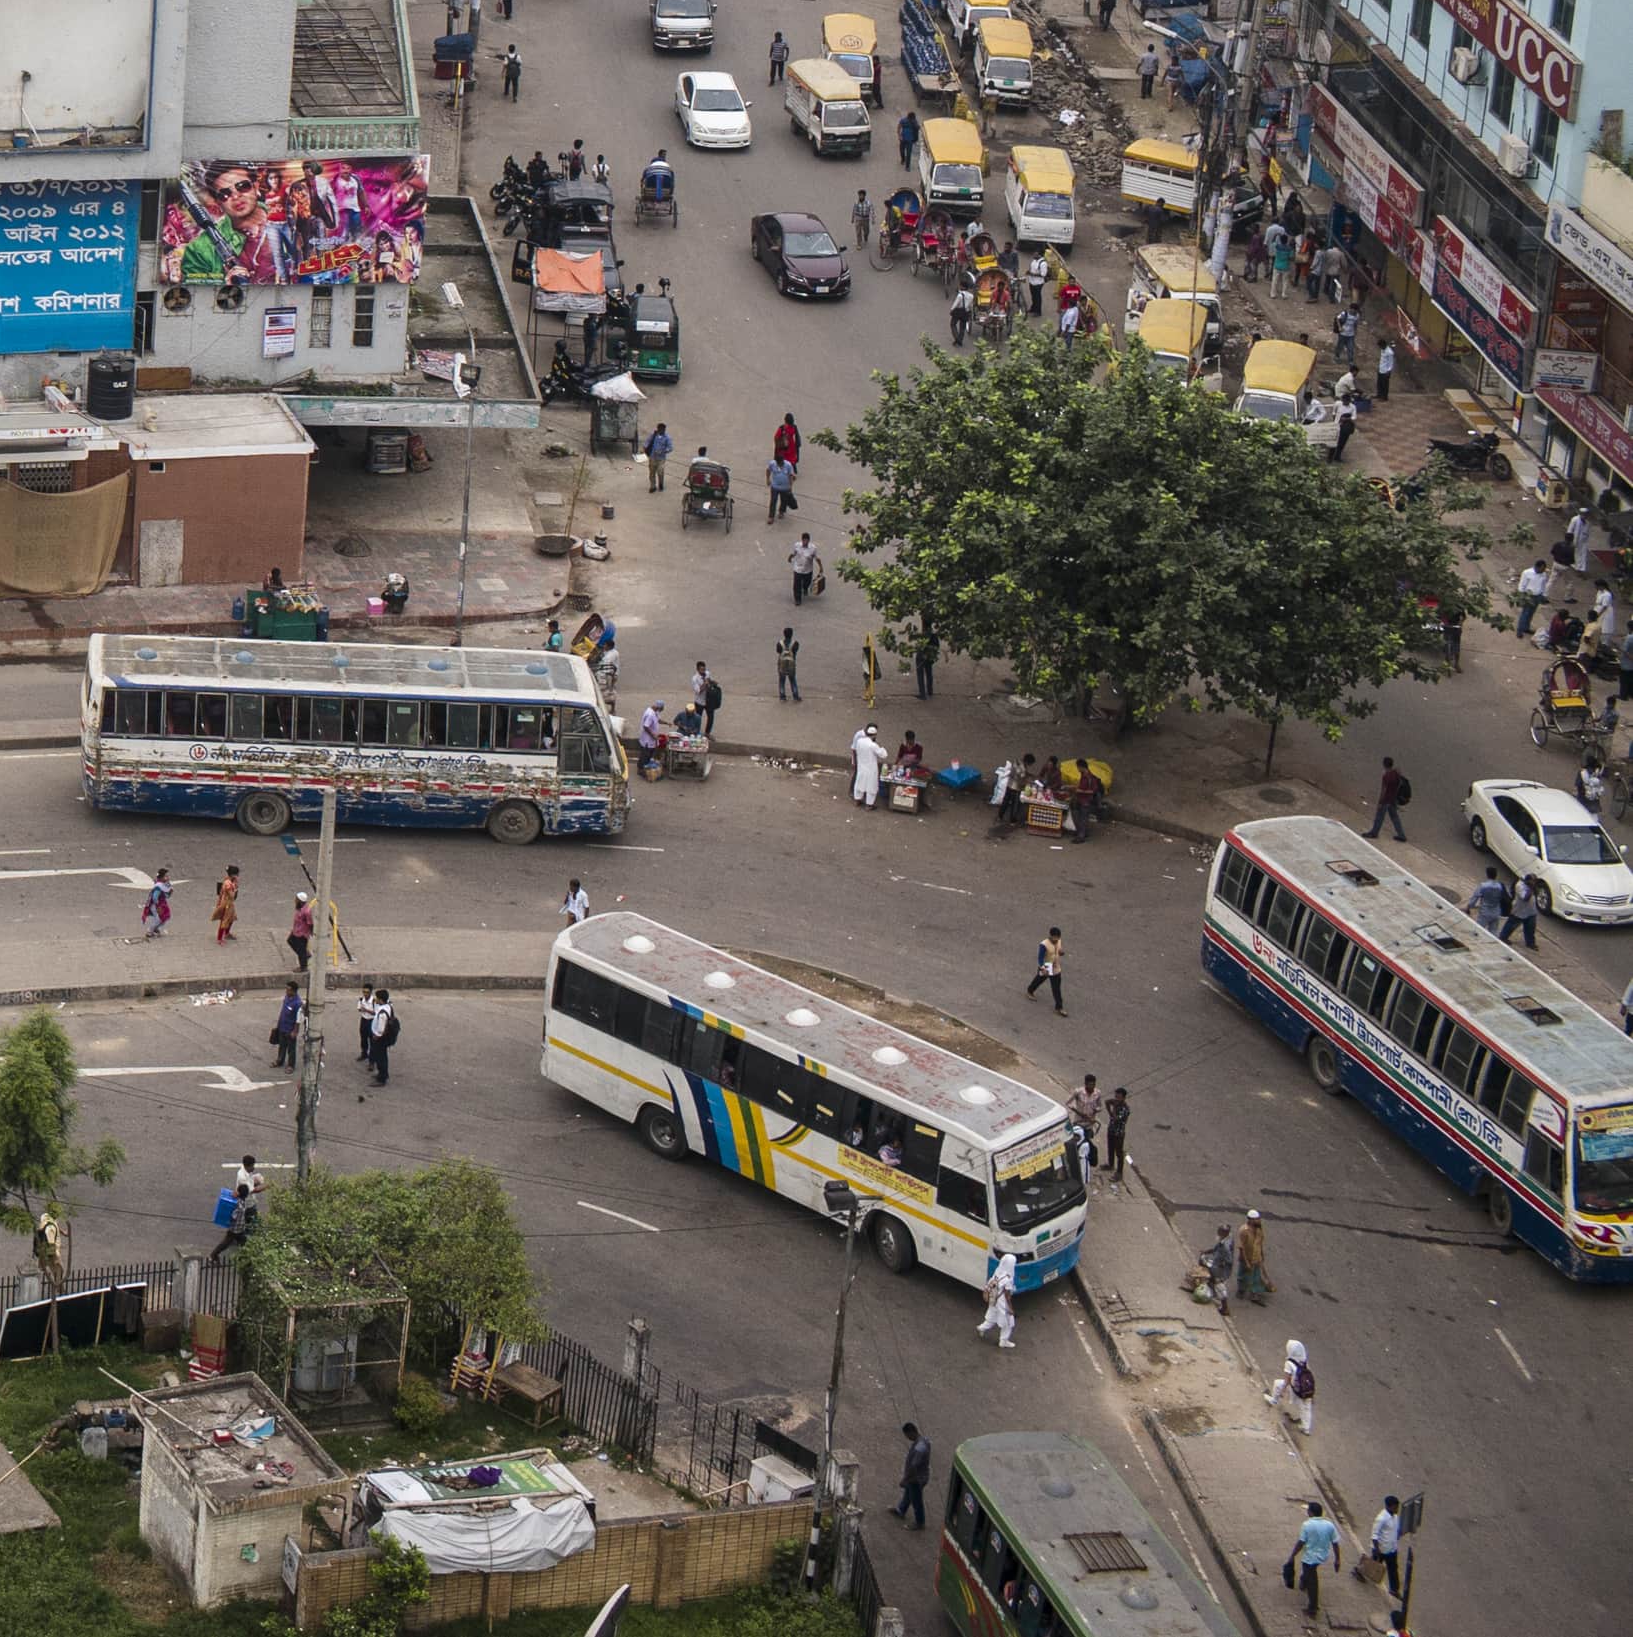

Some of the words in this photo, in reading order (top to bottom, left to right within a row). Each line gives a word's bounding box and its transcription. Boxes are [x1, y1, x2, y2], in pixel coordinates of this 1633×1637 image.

[1494, 1, 1570, 108] UCC
[69, 201, 100, 216] এর
[112, 201, 125, 216] ৪
[4, 223, 59, 243] আইন
[68, 223, 126, 242] ২০১২
[60, 245, 125, 264] আদেশ
[32, 289, 122, 312] কমিশনার
[1276, 956, 1321, 1004] মতিঝিল
[1321, 991, 1355, 1032] বনানী
